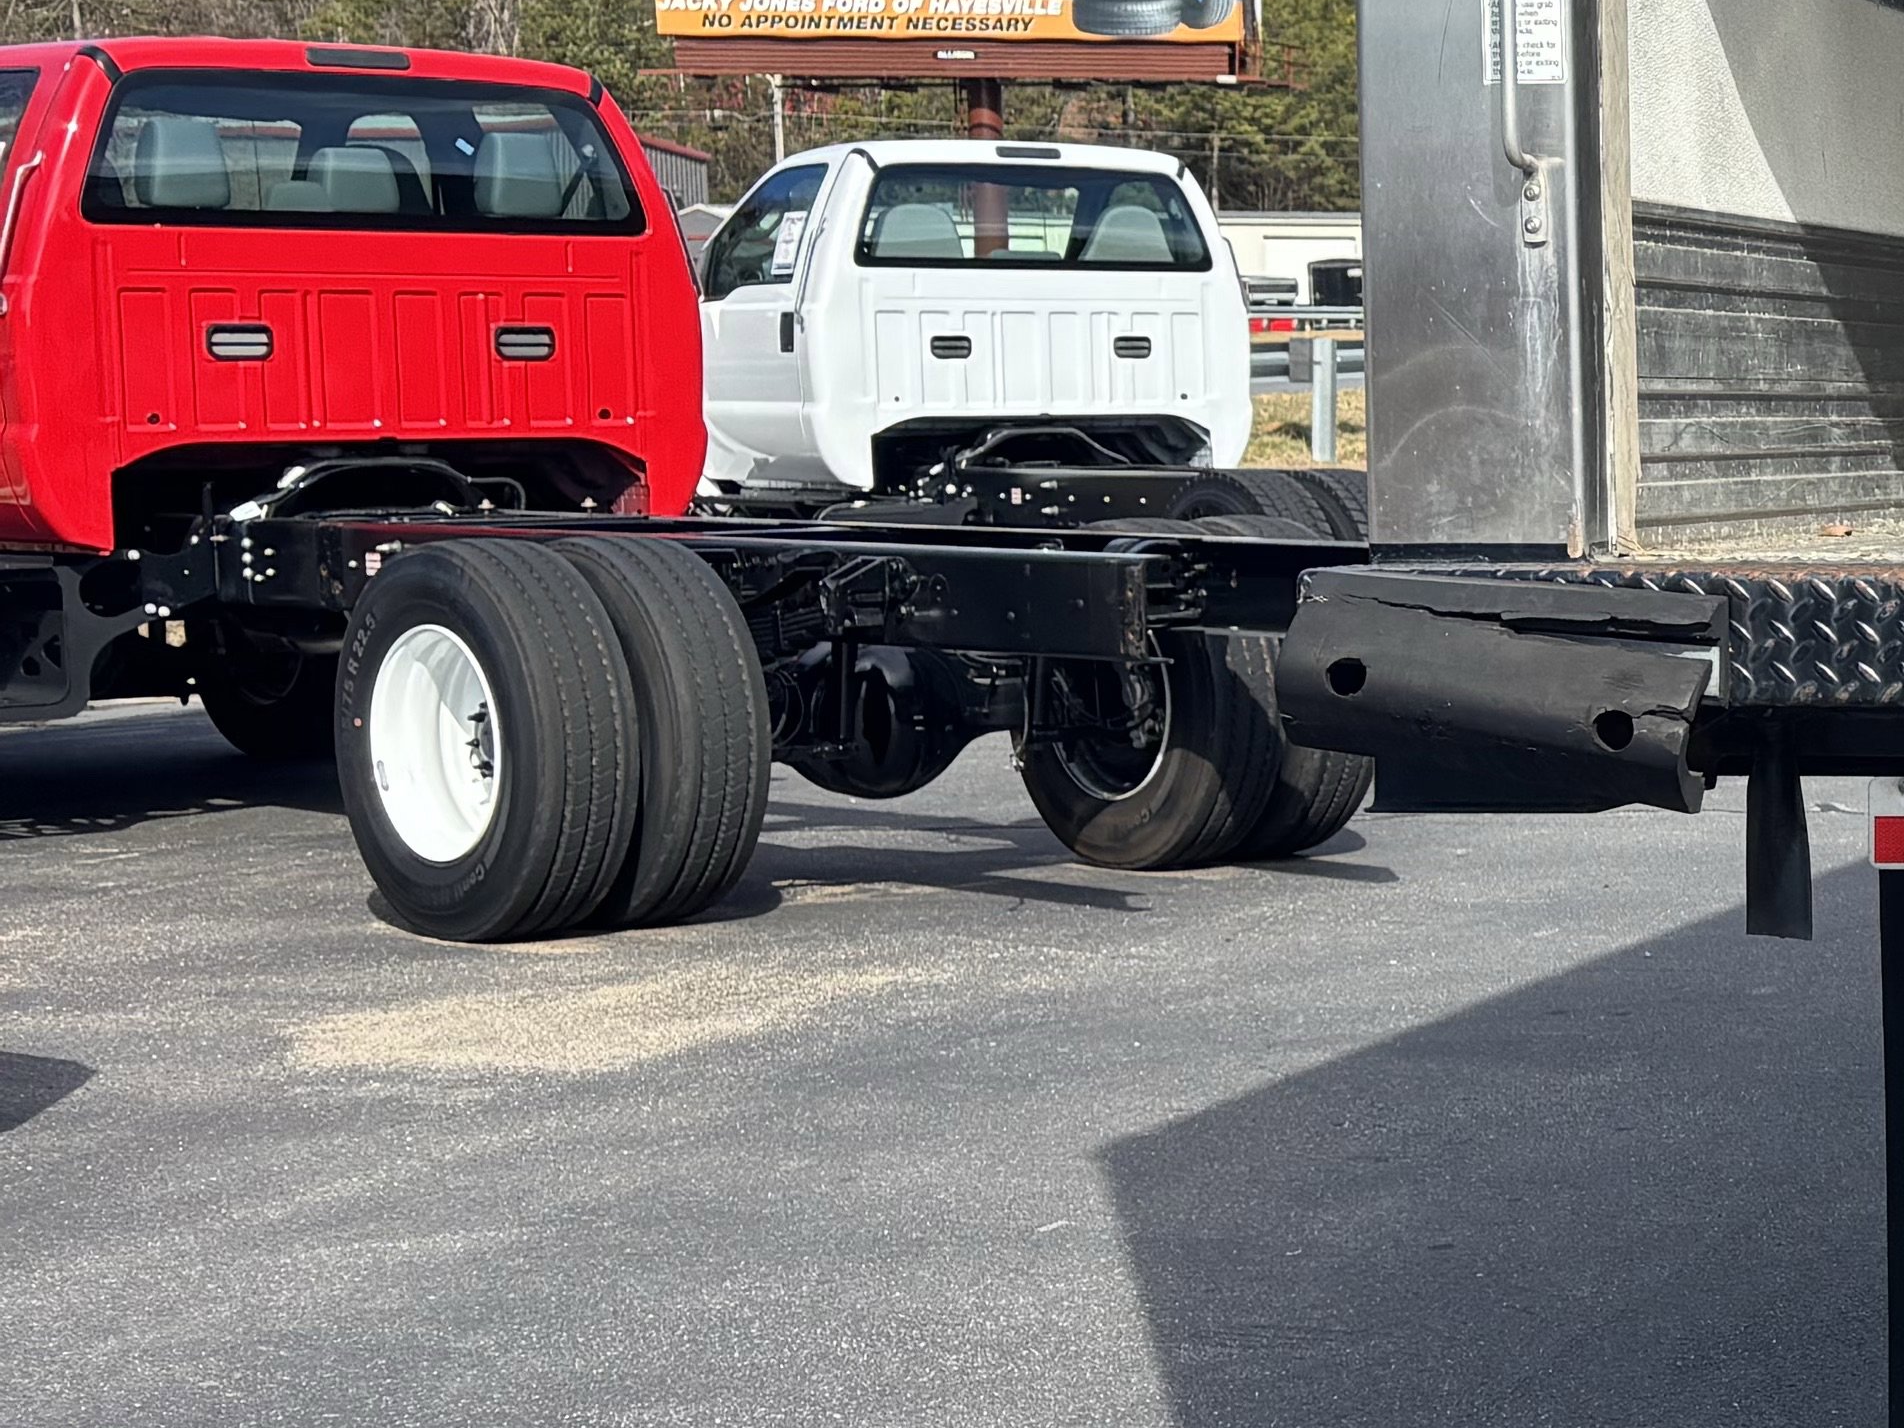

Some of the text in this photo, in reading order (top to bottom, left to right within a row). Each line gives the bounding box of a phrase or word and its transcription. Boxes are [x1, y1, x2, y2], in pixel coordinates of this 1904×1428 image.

[701, 13, 1034, 32] NO APPOINTMENT NECESSARY
